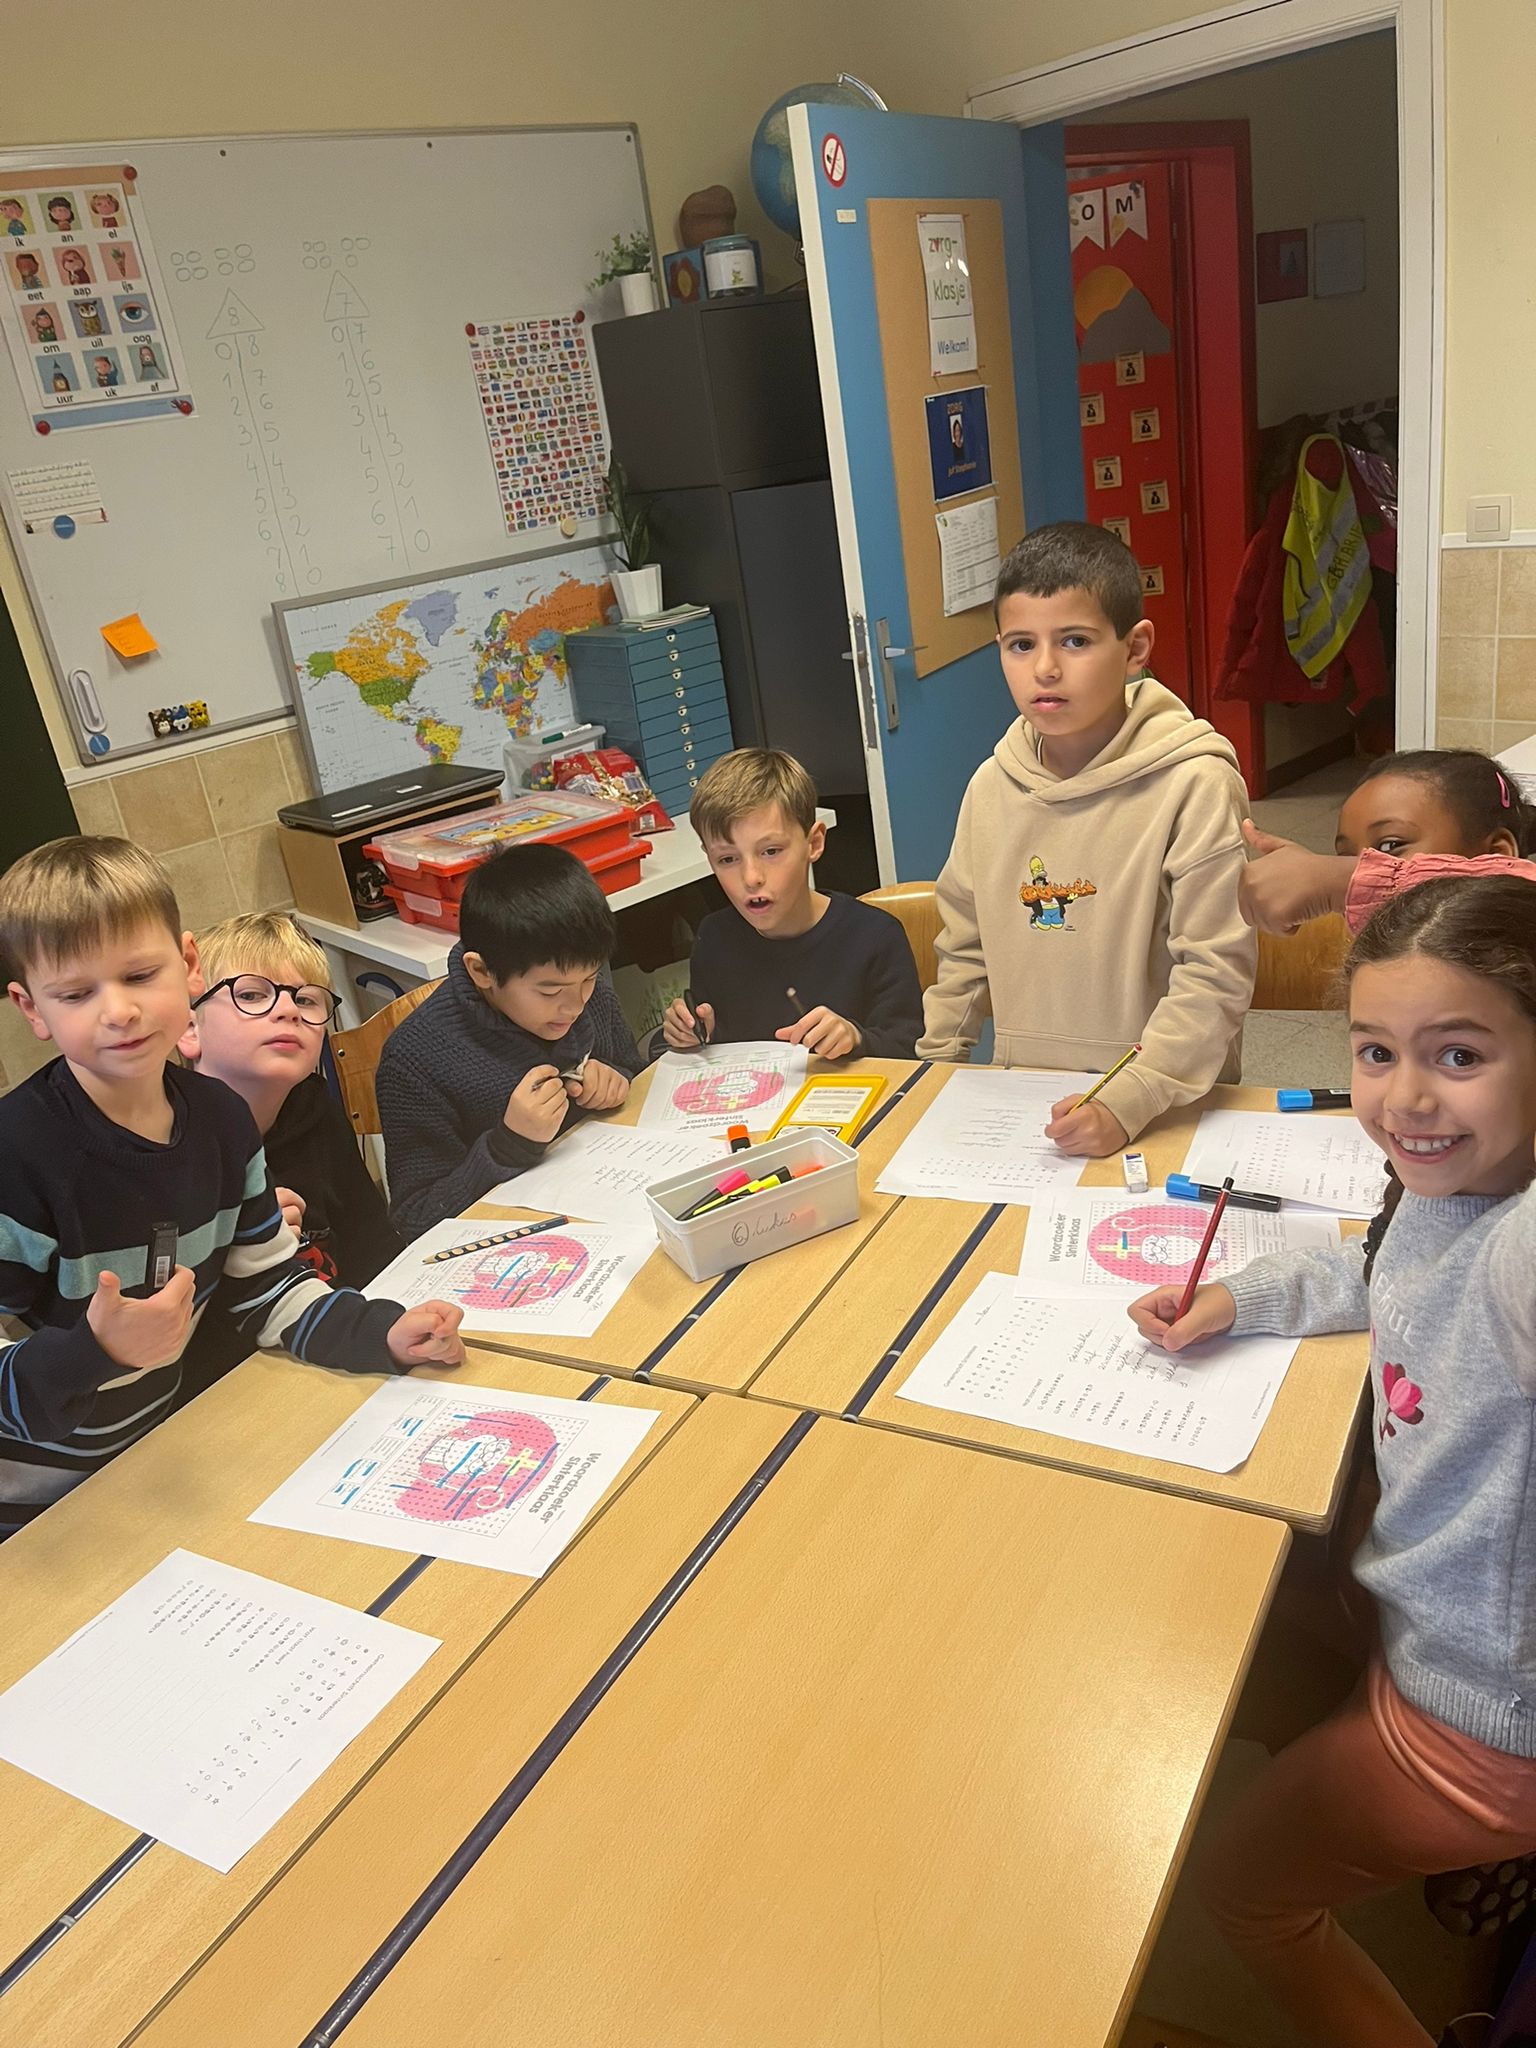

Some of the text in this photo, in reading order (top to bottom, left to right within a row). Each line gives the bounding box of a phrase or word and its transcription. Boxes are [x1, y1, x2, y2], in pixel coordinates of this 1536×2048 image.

[1082, 196, 1132, 220] O M
[14, 230, 118, 248] ik an el
[27, 281, 134, 301] eet aap ijs
[932, 278, 966, 306] klasje
[43, 334, 152, 354] om uil oog
[938, 338, 969, 355] Welkom!
[56, 382, 160, 404] uur uk af
[1048, 1214, 1066, 1262] Woordzoeker
[1065, 1218, 1080, 1258] Sinterklaas
[528, 1456, 581, 1514] Sinterklaas
[540, 1452, 602, 1524] Woordzoeker
